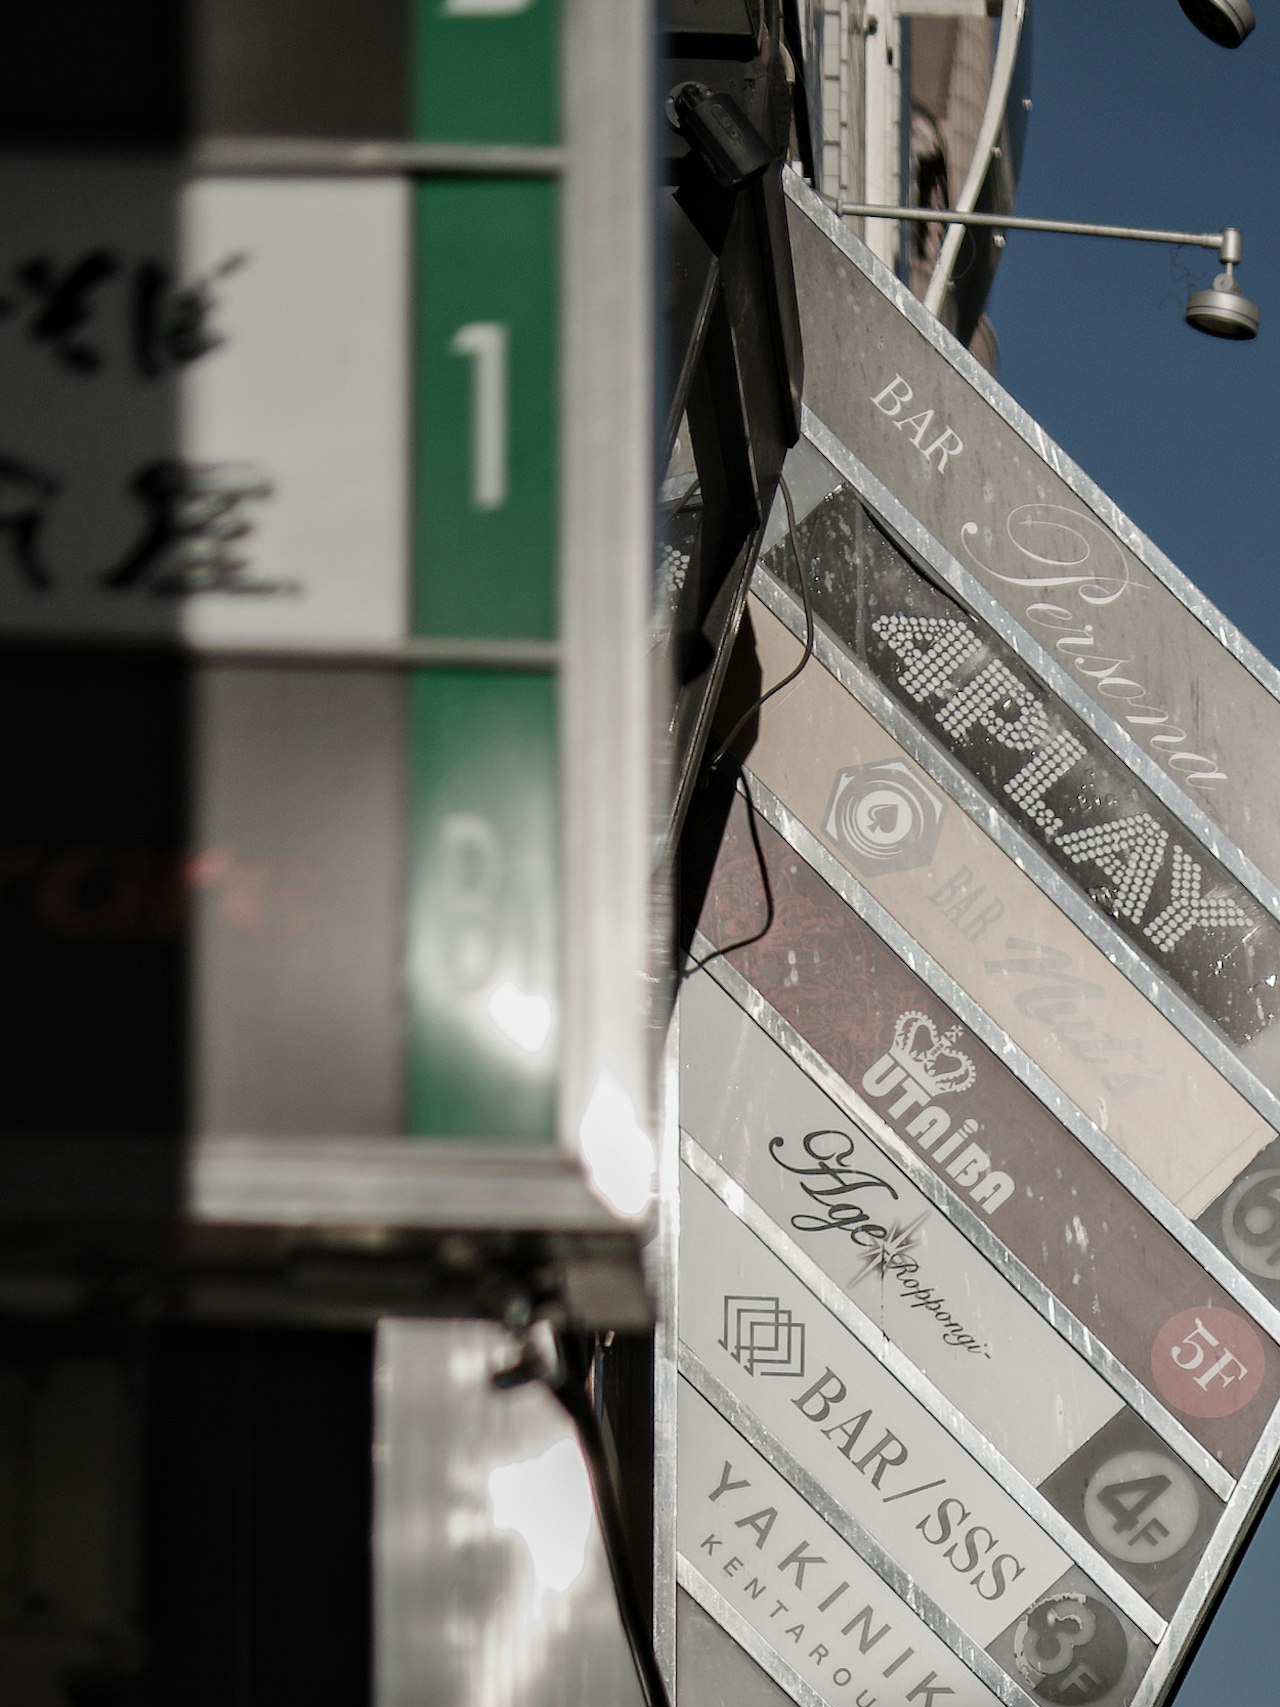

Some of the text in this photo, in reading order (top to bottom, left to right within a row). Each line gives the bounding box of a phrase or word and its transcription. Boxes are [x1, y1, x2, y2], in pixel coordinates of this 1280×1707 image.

[869, 373, 1228, 791] BAR Persona
[872, 614, 1254, 953] 4PLAY
[927, 864, 1005, 944] BAR
[768, 1130, 899, 1247] Age
[1171, 1317, 1248, 1392] 5F
[1097, 1474, 1171, 1548] 4F
